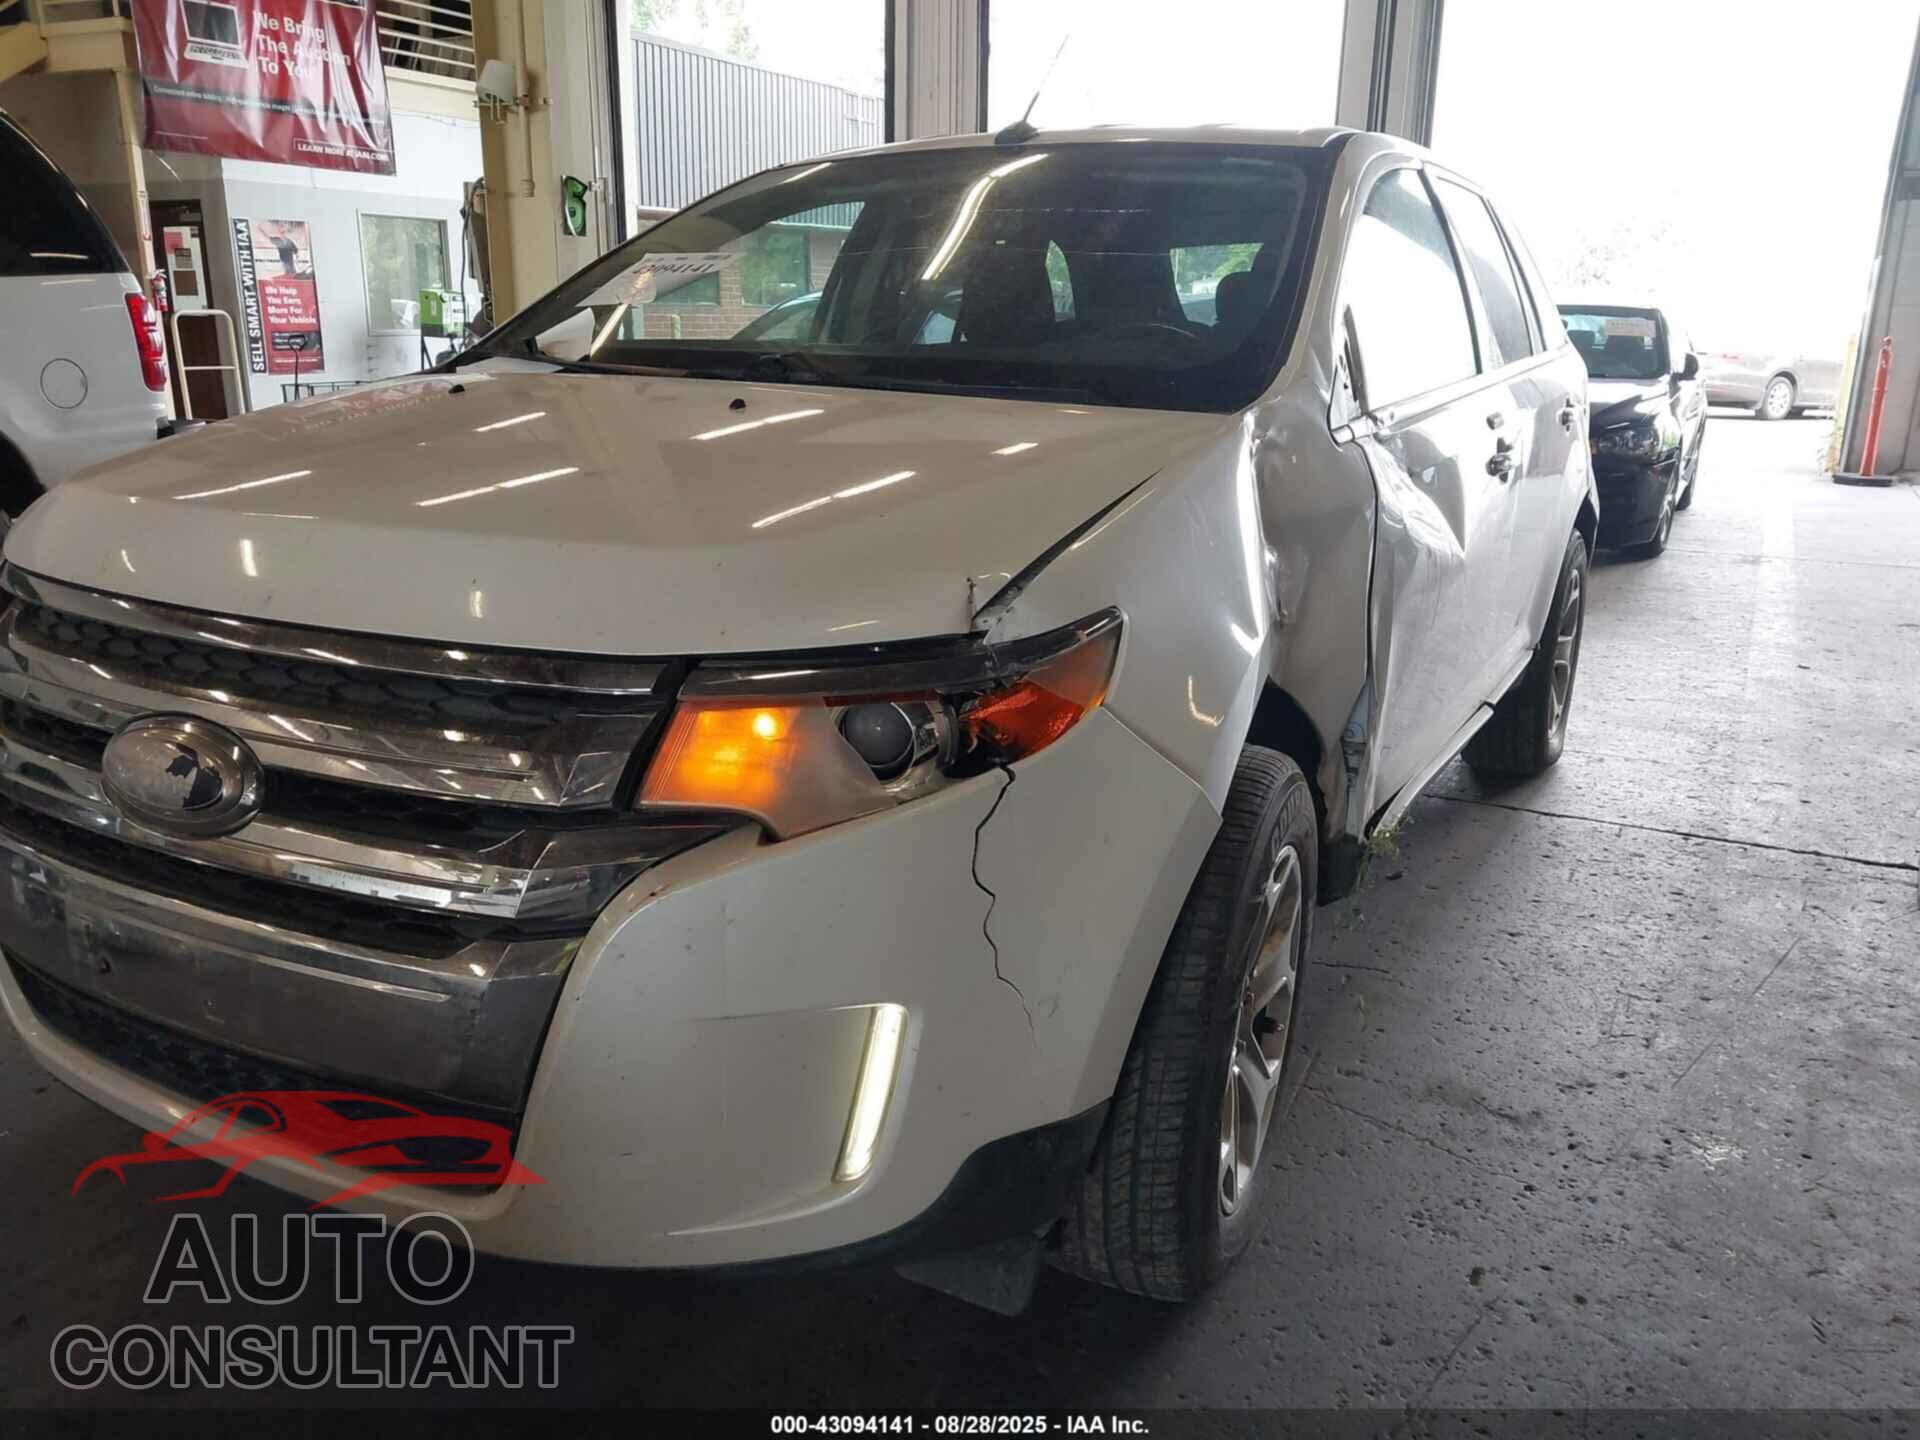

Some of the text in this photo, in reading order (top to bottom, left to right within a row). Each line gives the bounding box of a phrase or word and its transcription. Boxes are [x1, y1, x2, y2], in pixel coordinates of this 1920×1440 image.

[256, 34, 287, 54] The
[258, 56, 313, 80] To You
[236, 221, 265, 371] SELL SMART WITH IAA
